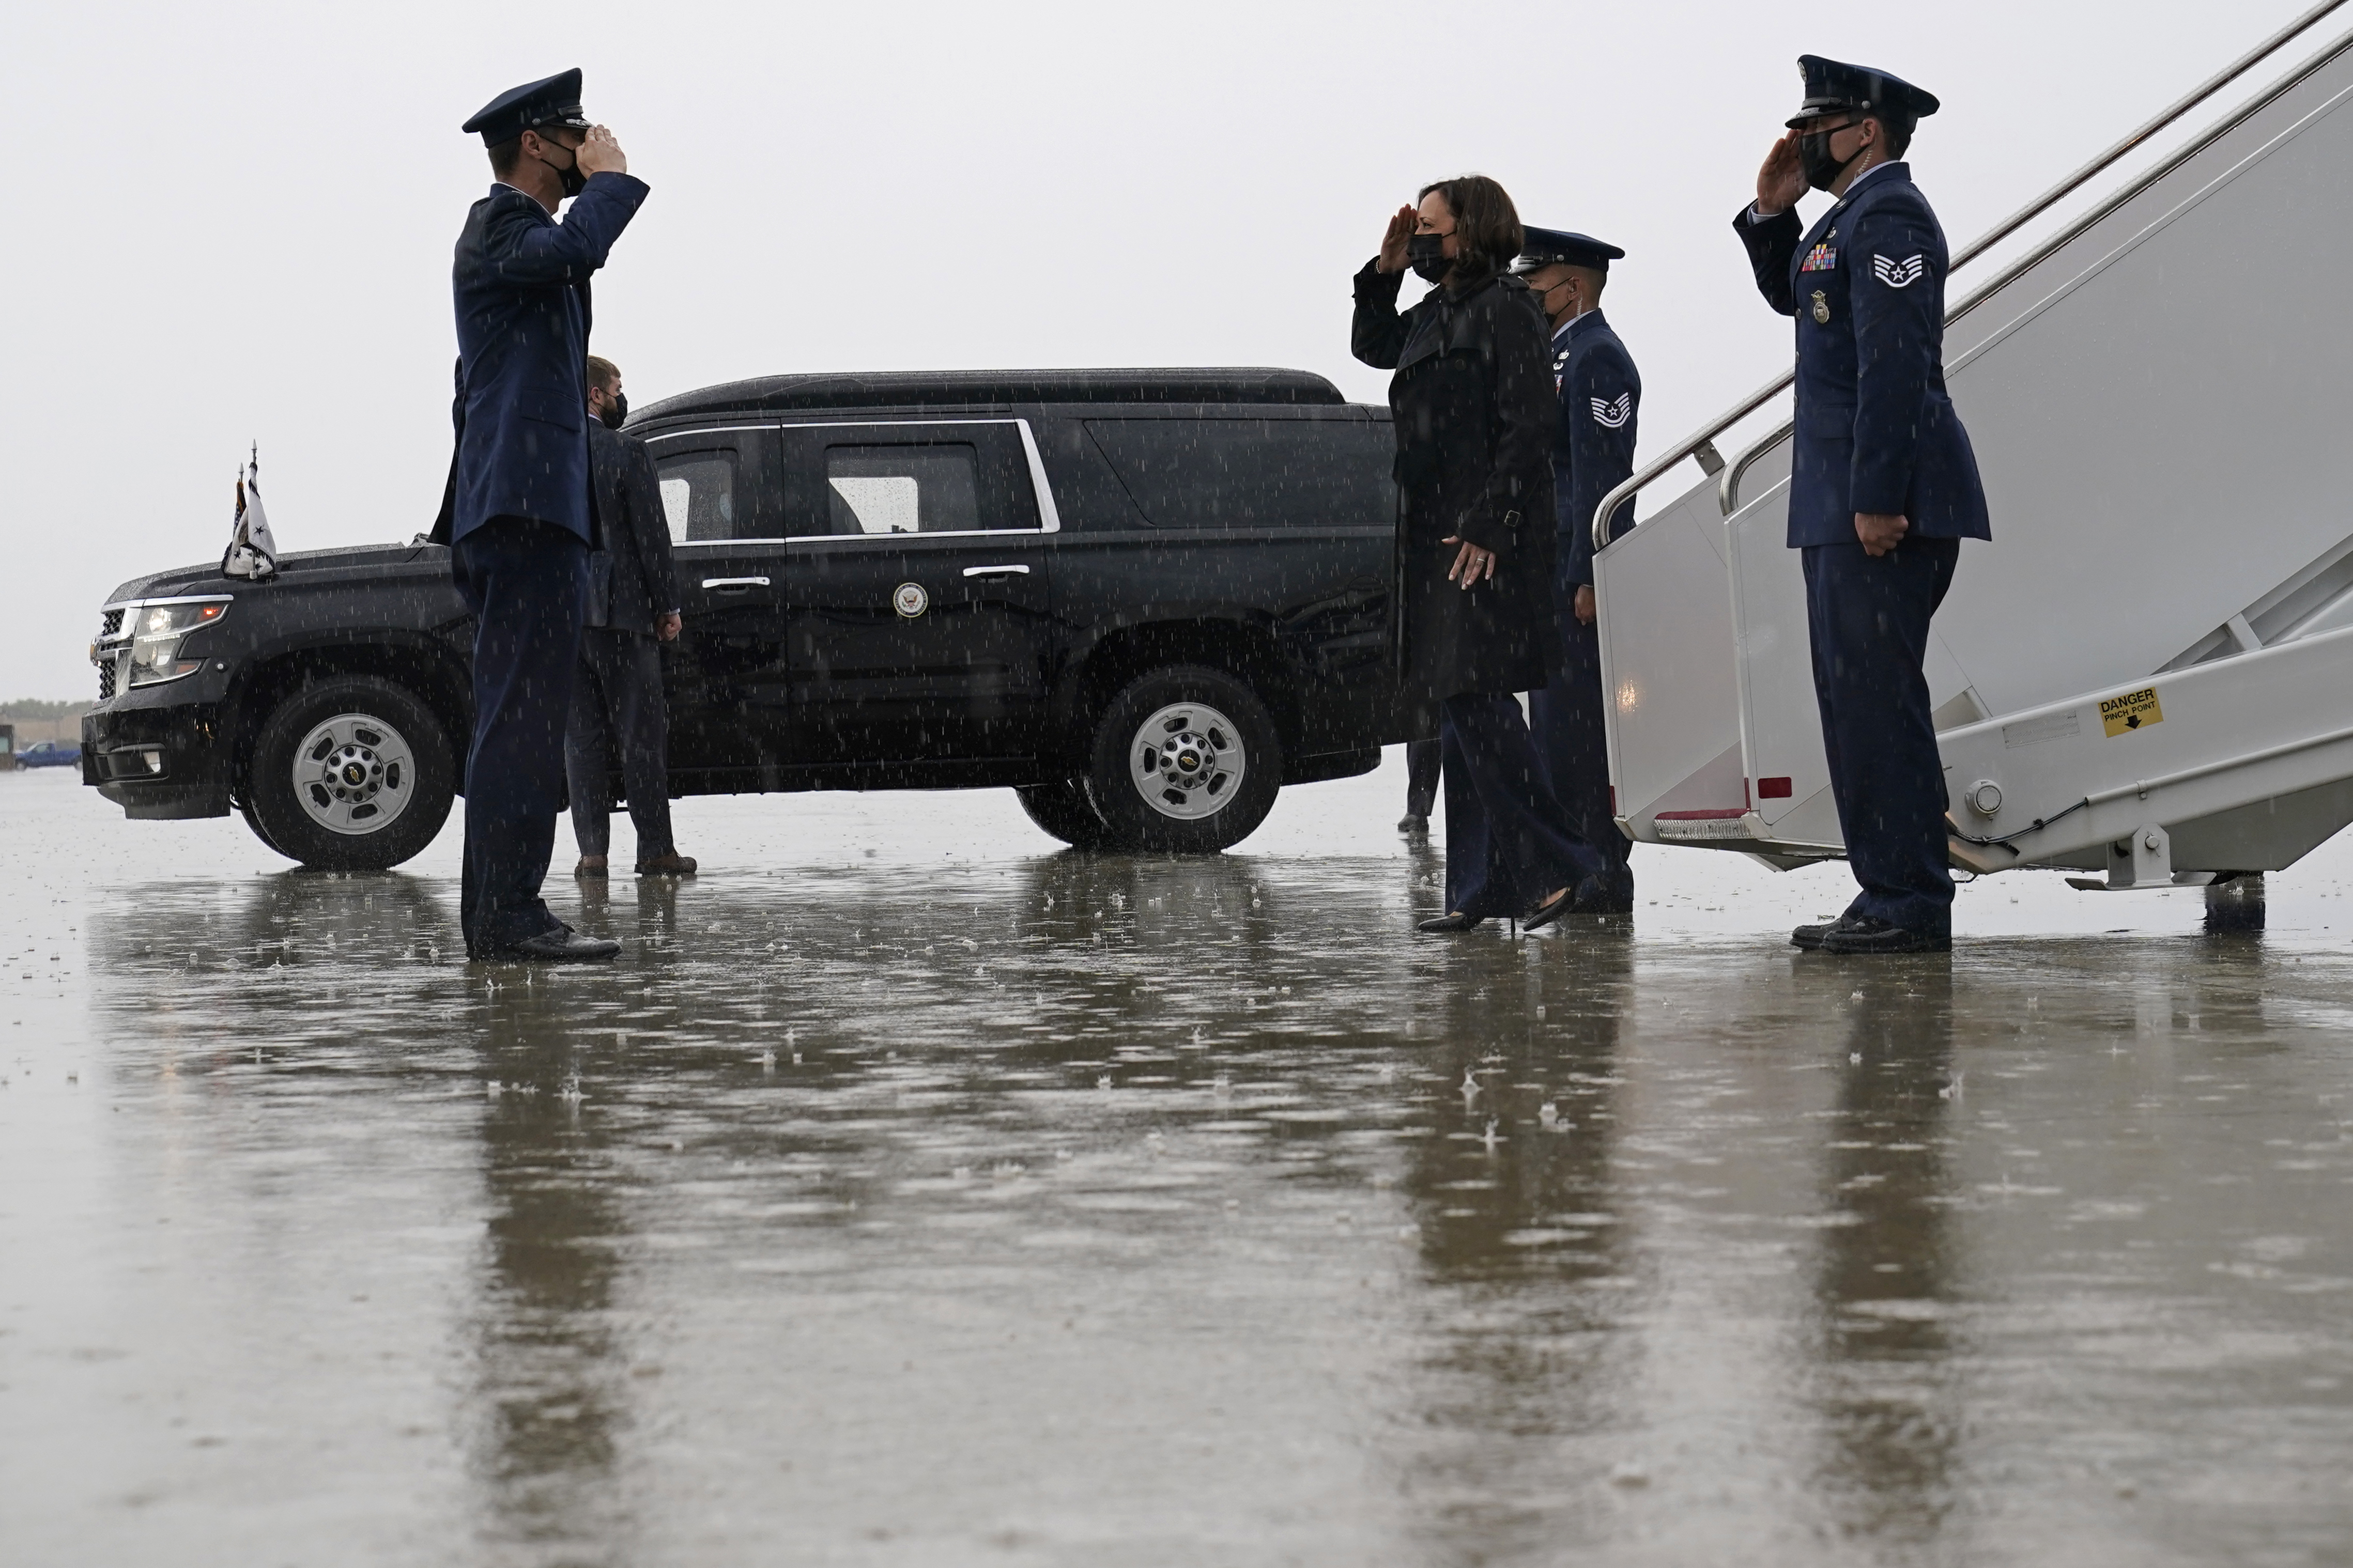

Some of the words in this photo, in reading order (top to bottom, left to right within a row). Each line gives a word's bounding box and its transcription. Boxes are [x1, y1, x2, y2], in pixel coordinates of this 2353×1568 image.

[2101, 689, 2154, 712] DANGER
[2104, 709, 2129, 722] PINCH
[2132, 701, 2155, 713] POINT
